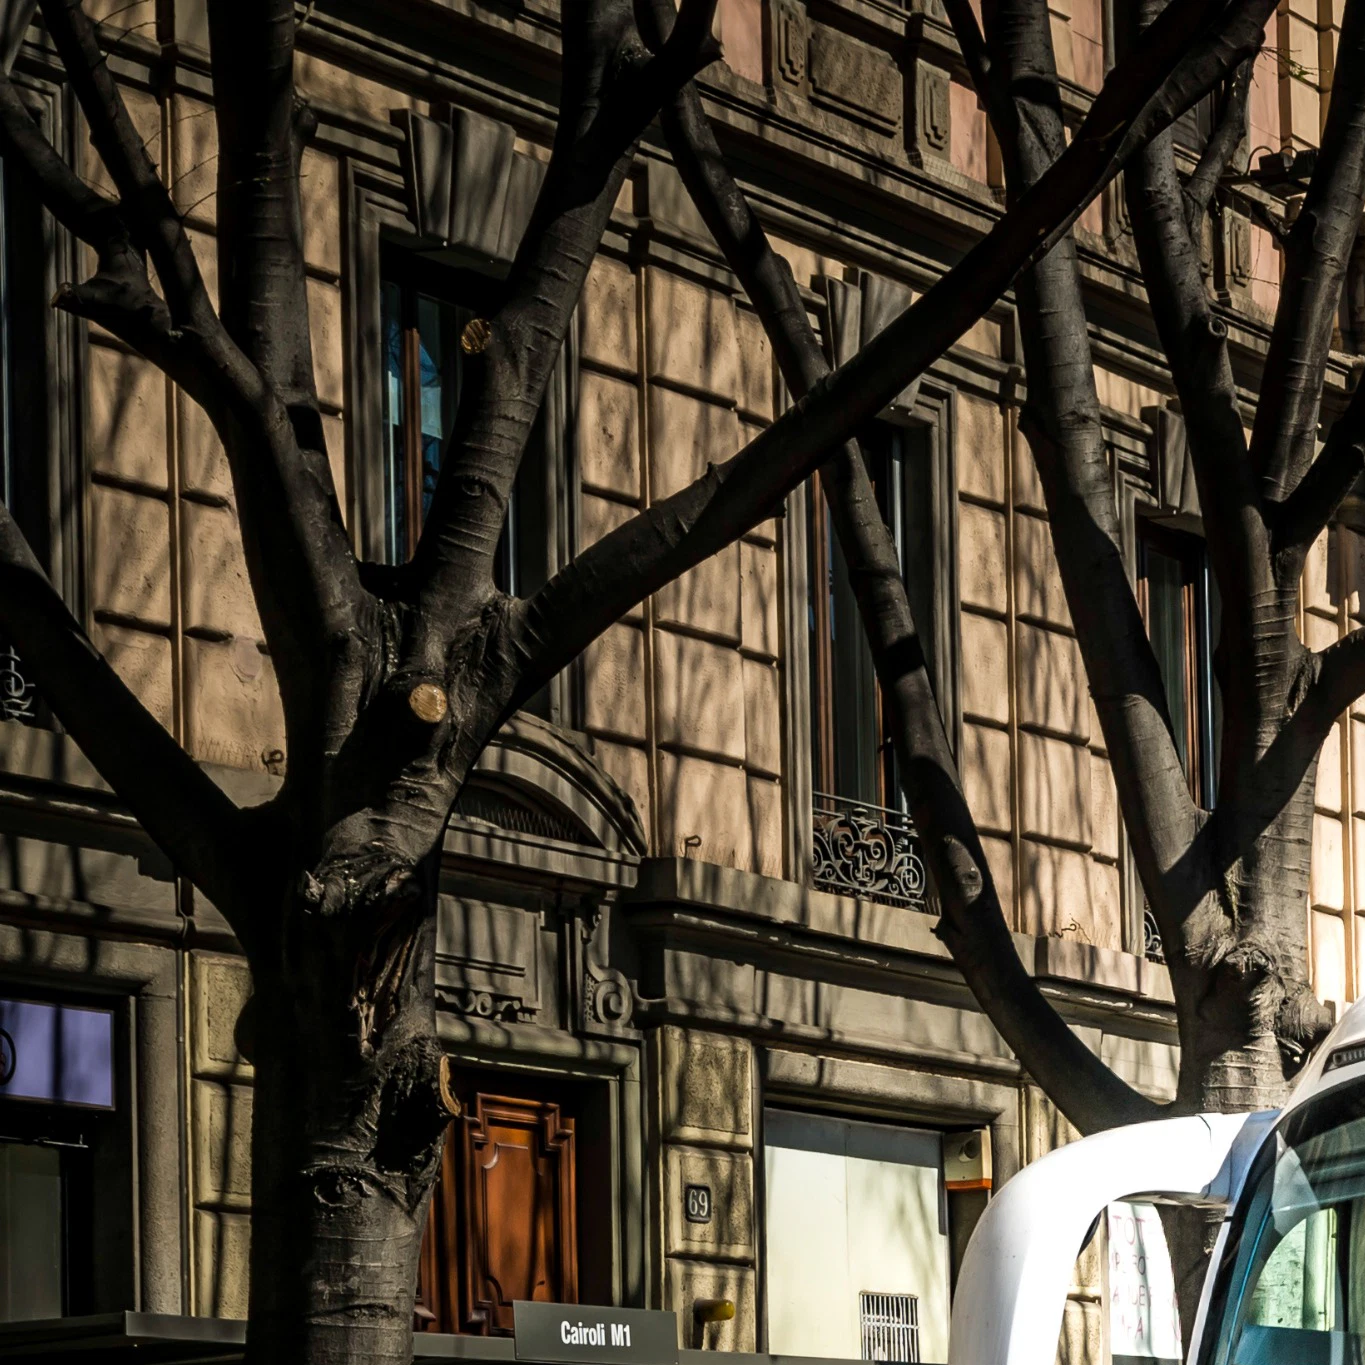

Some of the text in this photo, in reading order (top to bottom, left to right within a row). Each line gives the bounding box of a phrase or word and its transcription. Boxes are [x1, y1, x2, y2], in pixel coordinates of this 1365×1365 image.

[688, 1189, 708, 1217] 69
[561, 1320, 631, 1347] Cairoli M1
